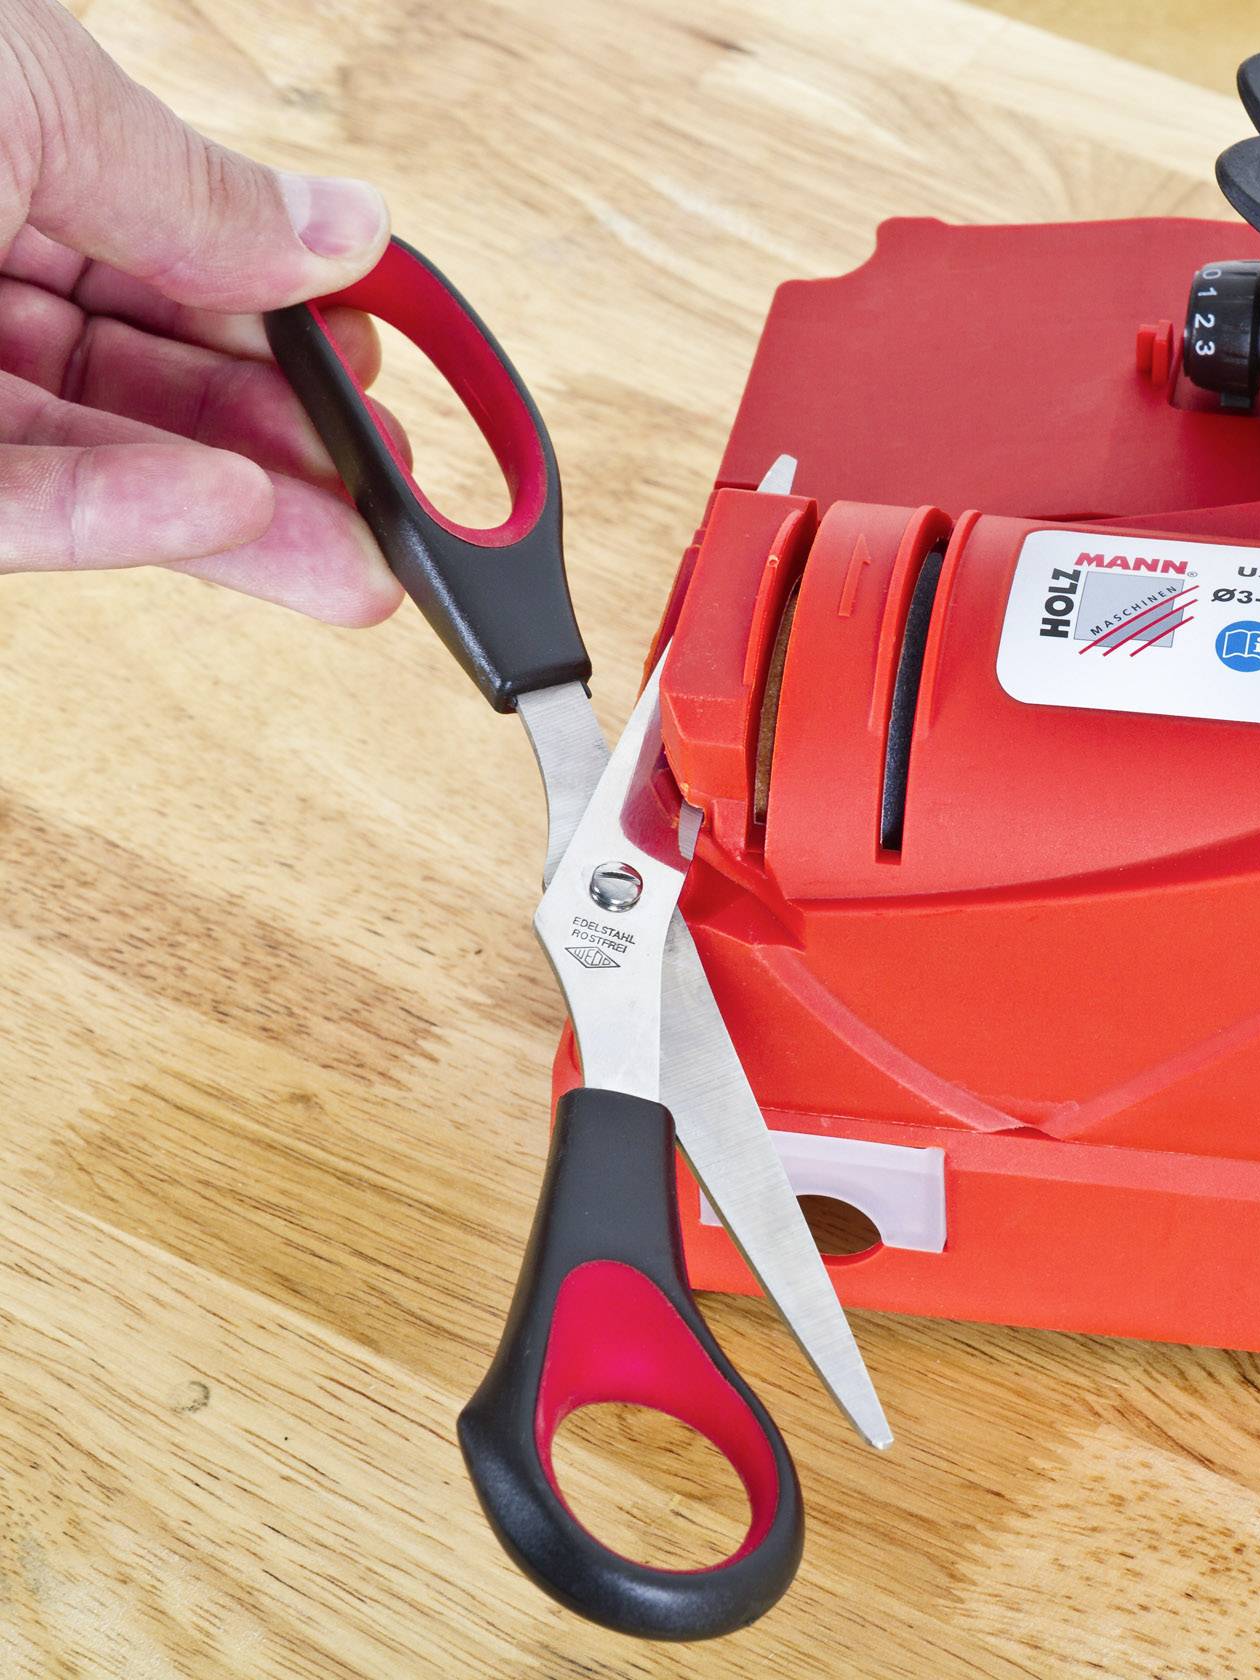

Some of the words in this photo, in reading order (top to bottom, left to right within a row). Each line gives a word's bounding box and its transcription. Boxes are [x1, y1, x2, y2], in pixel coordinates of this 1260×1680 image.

[1202, 268, 1222, 280] 0
[1197, 287, 1218, 297] 1
[1195, 313, 1216, 329] 2
[1195, 340, 1216, 356] 3
[1039, 568, 1081, 639] HOLZ
[1090, 585, 1177, 636] MASCHINEN
[571, 928, 628, 954] ROSTFREI
[572, 916, 636, 945] EDELSTAHL
